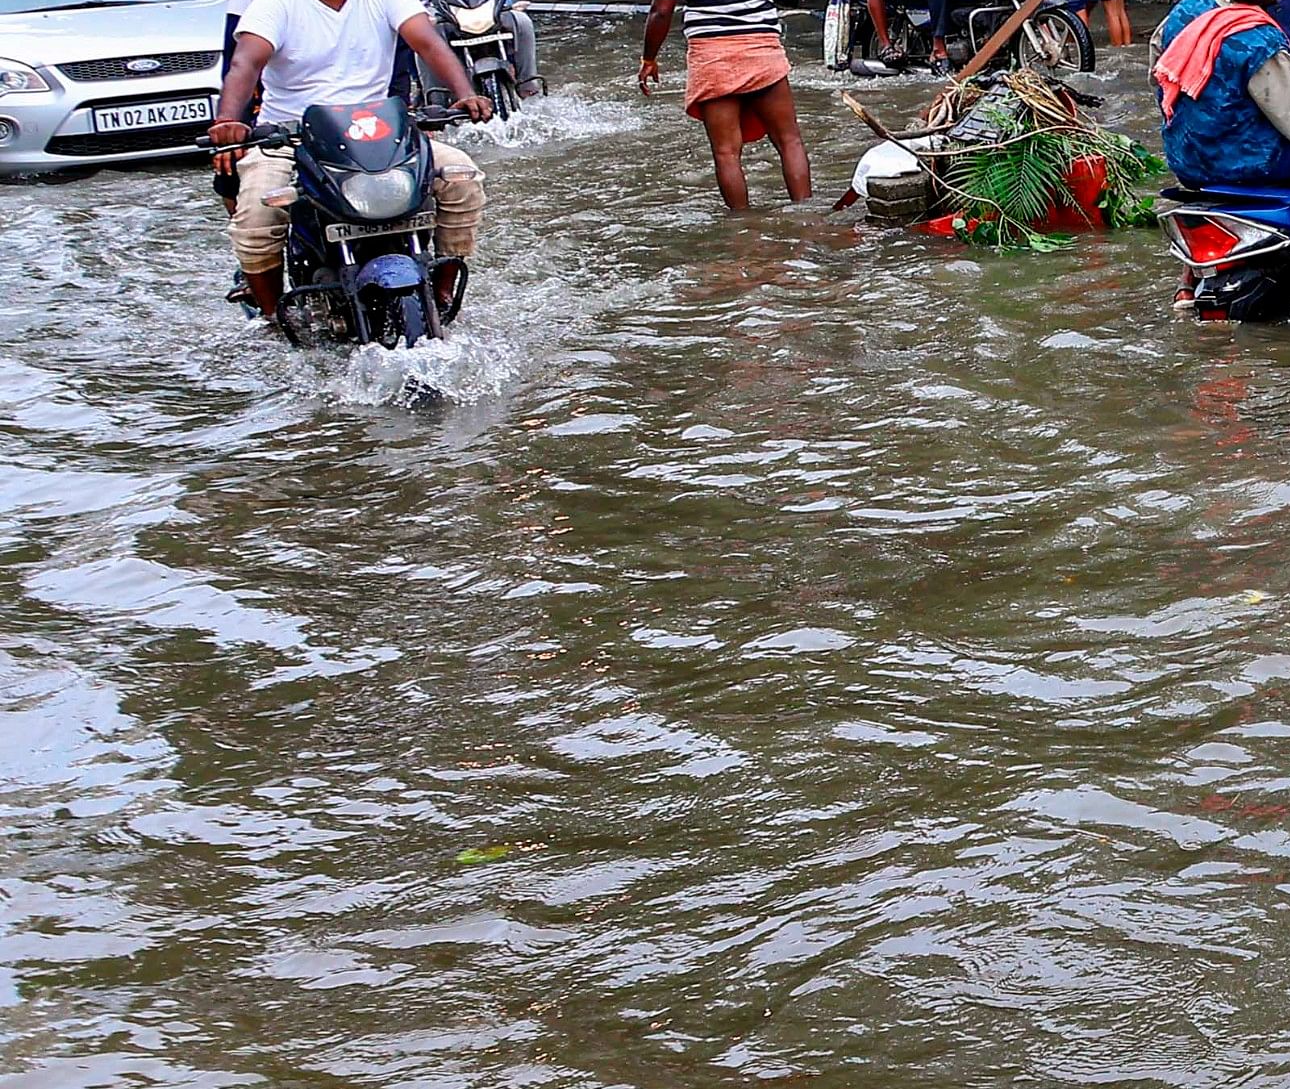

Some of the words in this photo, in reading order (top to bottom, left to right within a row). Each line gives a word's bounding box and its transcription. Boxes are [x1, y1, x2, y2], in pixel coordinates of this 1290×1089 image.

[100, 112, 120, 129] TN
[124, 110, 144, 126] 02
[148, 107, 168, 124] AK
[170, 102, 206, 121] 2259
[336, 225, 351, 238] TN
